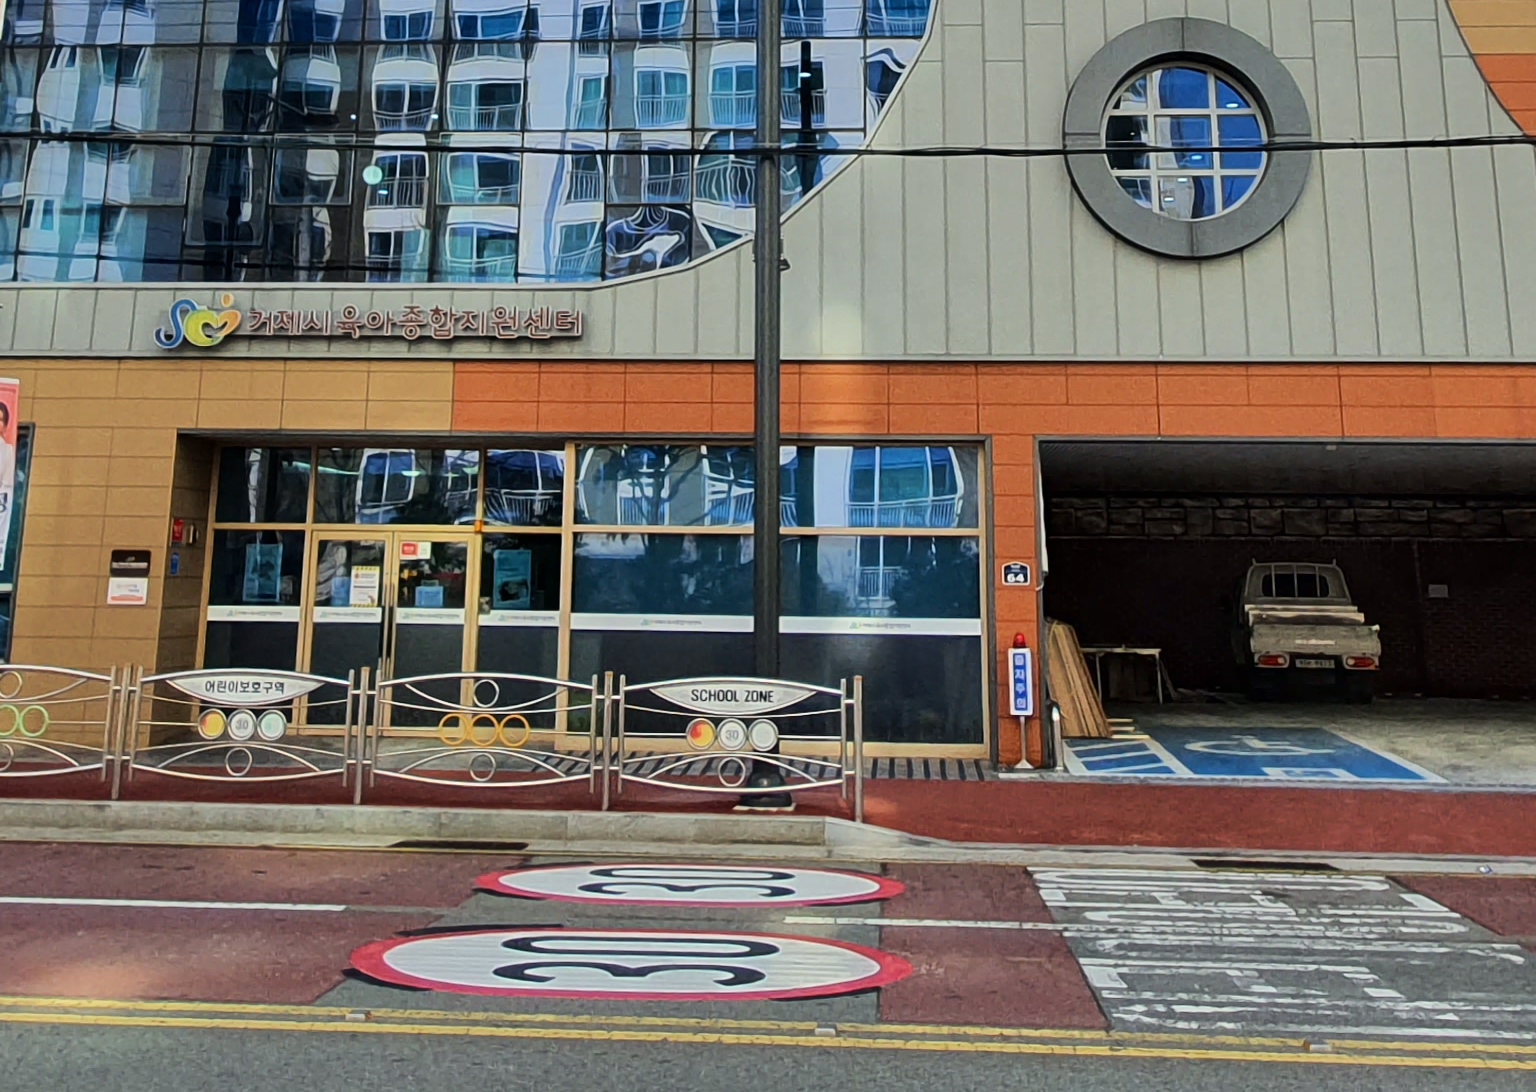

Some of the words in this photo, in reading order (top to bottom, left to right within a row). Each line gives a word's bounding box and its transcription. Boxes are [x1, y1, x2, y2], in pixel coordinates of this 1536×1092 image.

[1007, 573, 1024, 583] 64
[204, 680, 284, 694] 어린이보호구역
[691, 689, 739, 702] SCHOOL
[744, 690, 774, 703] ZONE
[725, 729, 739, 741] 30
[576, 866, 796, 899] 30
[492, 935, 781, 988] 30
